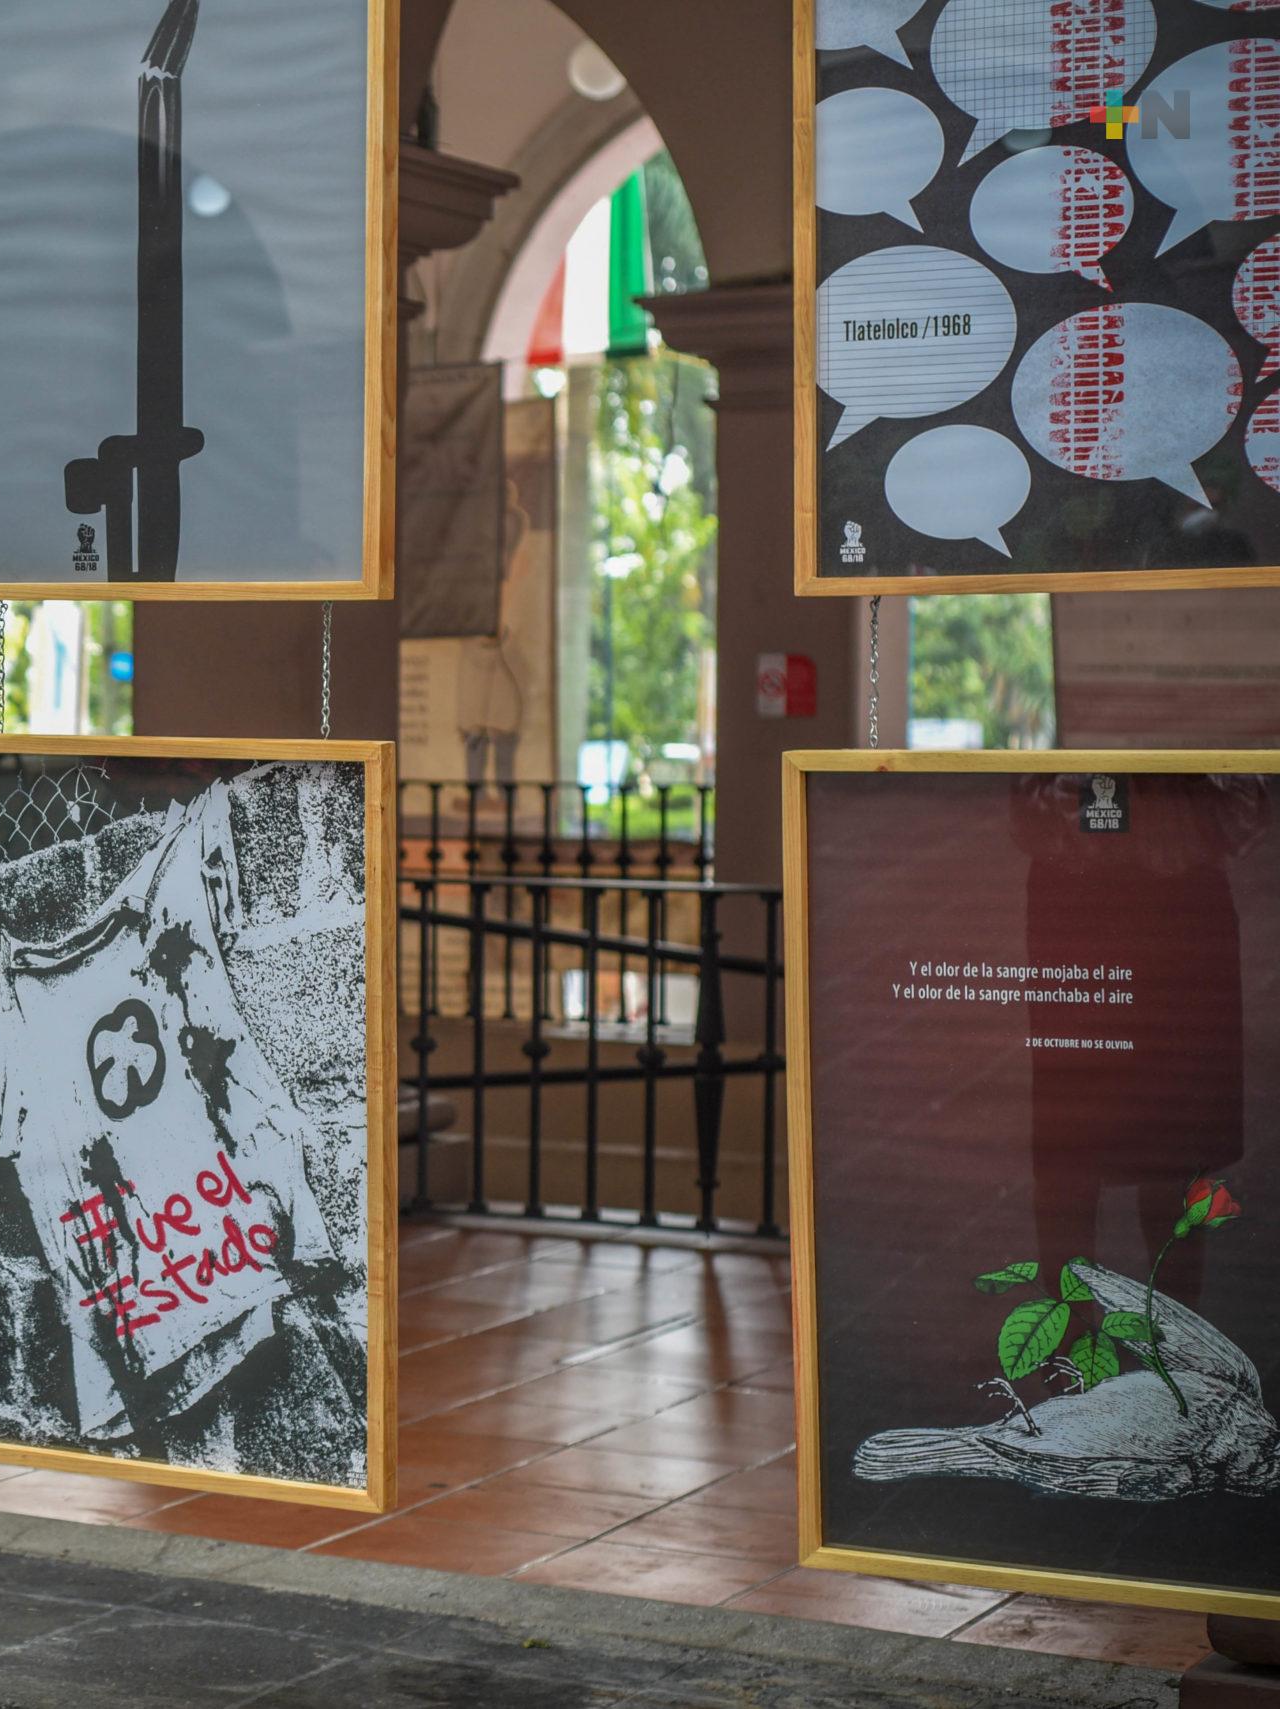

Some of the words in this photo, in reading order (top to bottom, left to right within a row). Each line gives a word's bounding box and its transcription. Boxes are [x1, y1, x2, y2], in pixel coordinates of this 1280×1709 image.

[843, 317, 919, 342] Tlatelolco
[74, 561, 98, 571] 68/18
[1089, 818, 1119, 829] 68/18
[909, 961, 918, 976] Y
[920, 961, 932, 977] el
[935, 961, 960, 977] olor
[963, 962, 979, 978] de
[981, 962, 993, 978] la
[996, 966, 1038, 983] sangre
[1042, 964, 1090, 983] mojaba
[1092, 964, 1105, 980] el
[1107, 966, 1133, 981] aire
[892, 984, 901, 999] Y
[903, 984, 915, 999] el
[918, 984, 943, 1000] olor
[945, 985, 961, 1001] de
[964, 985, 976, 1001] la
[979, 988, 1021, 1005] sangre
[1024, 987, 1090, 1004] manchaba
[1093, 988, 1105, 1004] el
[1108, 990, 1134, 1005] aire
[1025, 1038, 1031, 1048] 2
[1032, 1038, 1043, 1048] DE
[1044, 1039, 1080, 1049] OCTUBRE
[1081, 1040, 1093, 1049] NO
[1094, 1040, 1104, 1049] SE
[1105, 1041, 1134, 1051] OLVIDA
[196, 1150, 253, 1208] el
[78, 1215, 279, 1338] Estado
